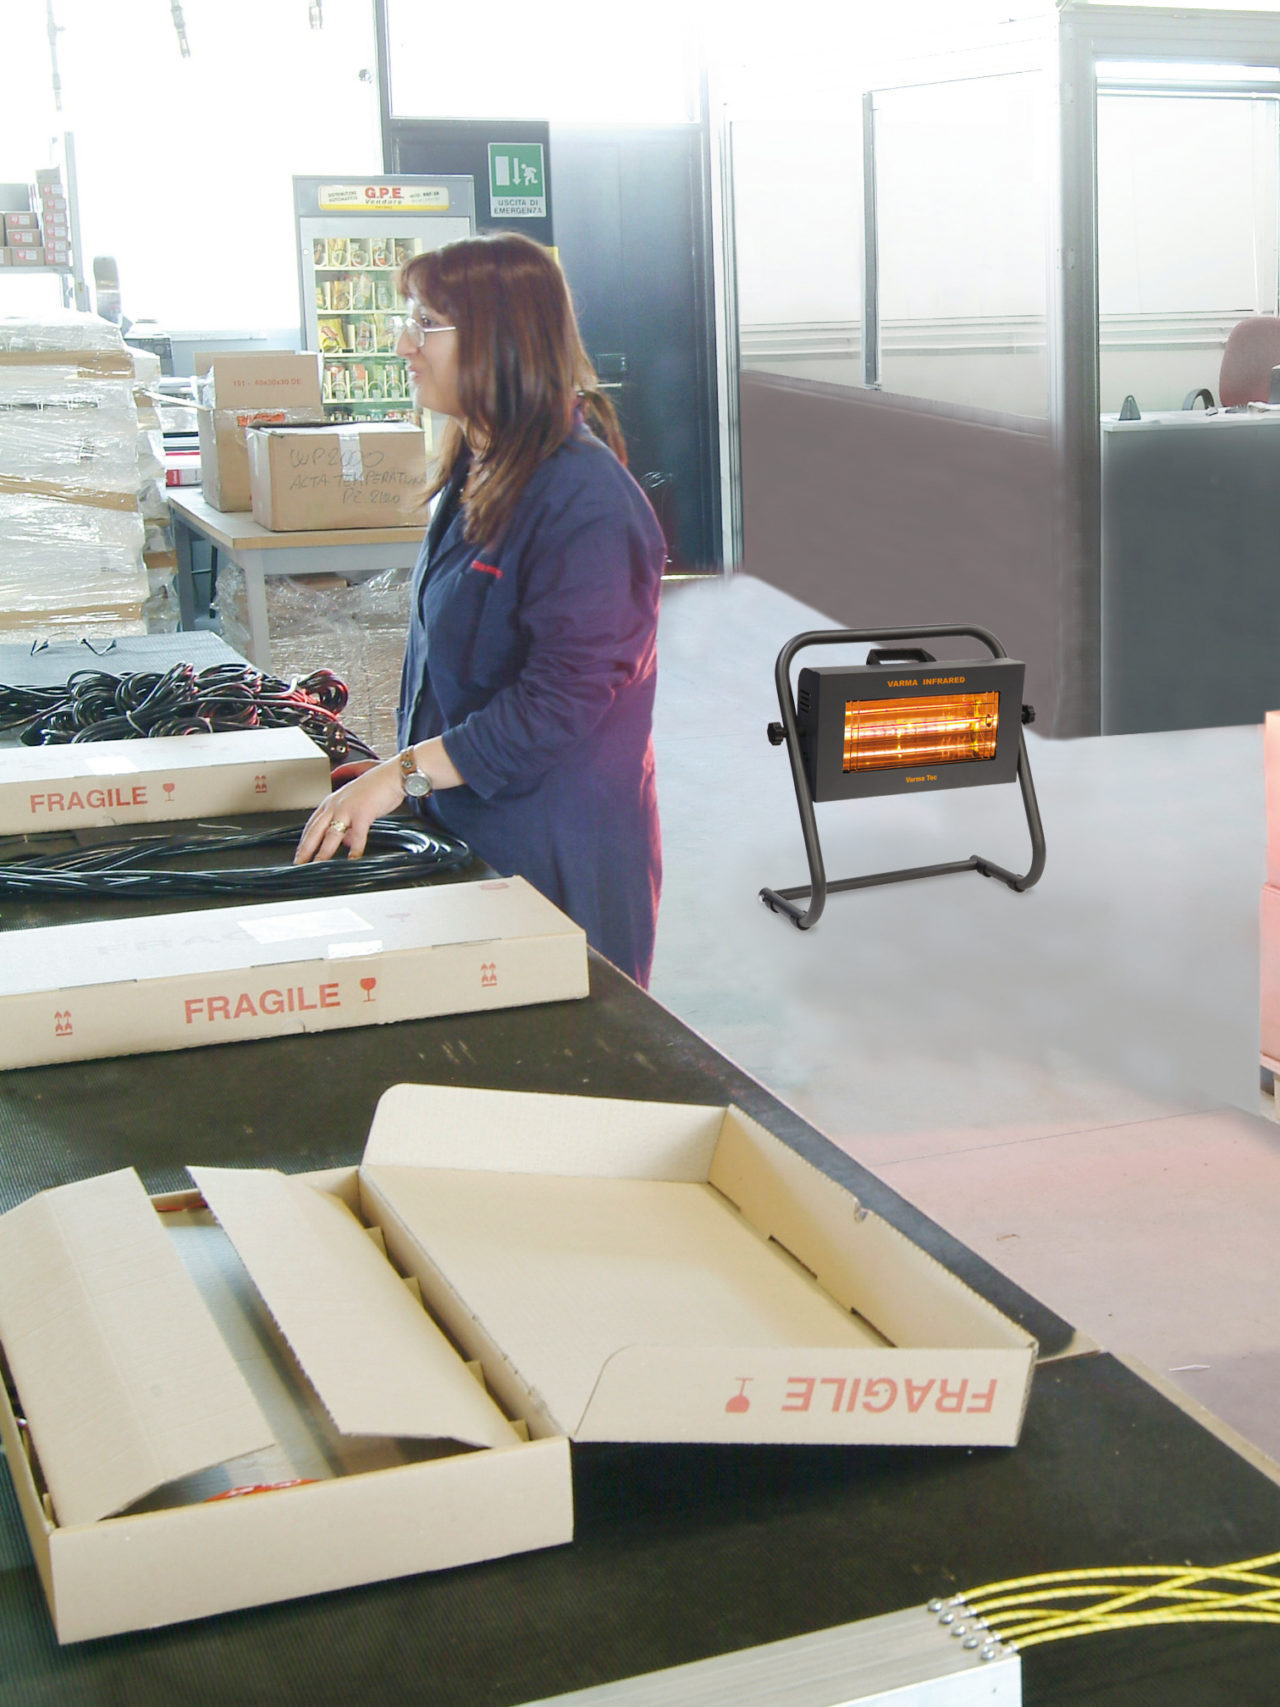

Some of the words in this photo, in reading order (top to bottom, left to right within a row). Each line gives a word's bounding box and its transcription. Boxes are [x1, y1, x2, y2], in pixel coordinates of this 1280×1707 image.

[498, 199, 527, 207] USCITA
[494, 207, 543, 215] EMERGENZA
[887, 680, 918, 688] VARMA
[923, 676, 966, 686] INFRARED
[906, 775, 926, 783] Varma
[30, 786, 148, 813] FRAGILE
[184, 983, 341, 1024] FRAGILE
[781, 1377, 998, 1414] FRAGILE
